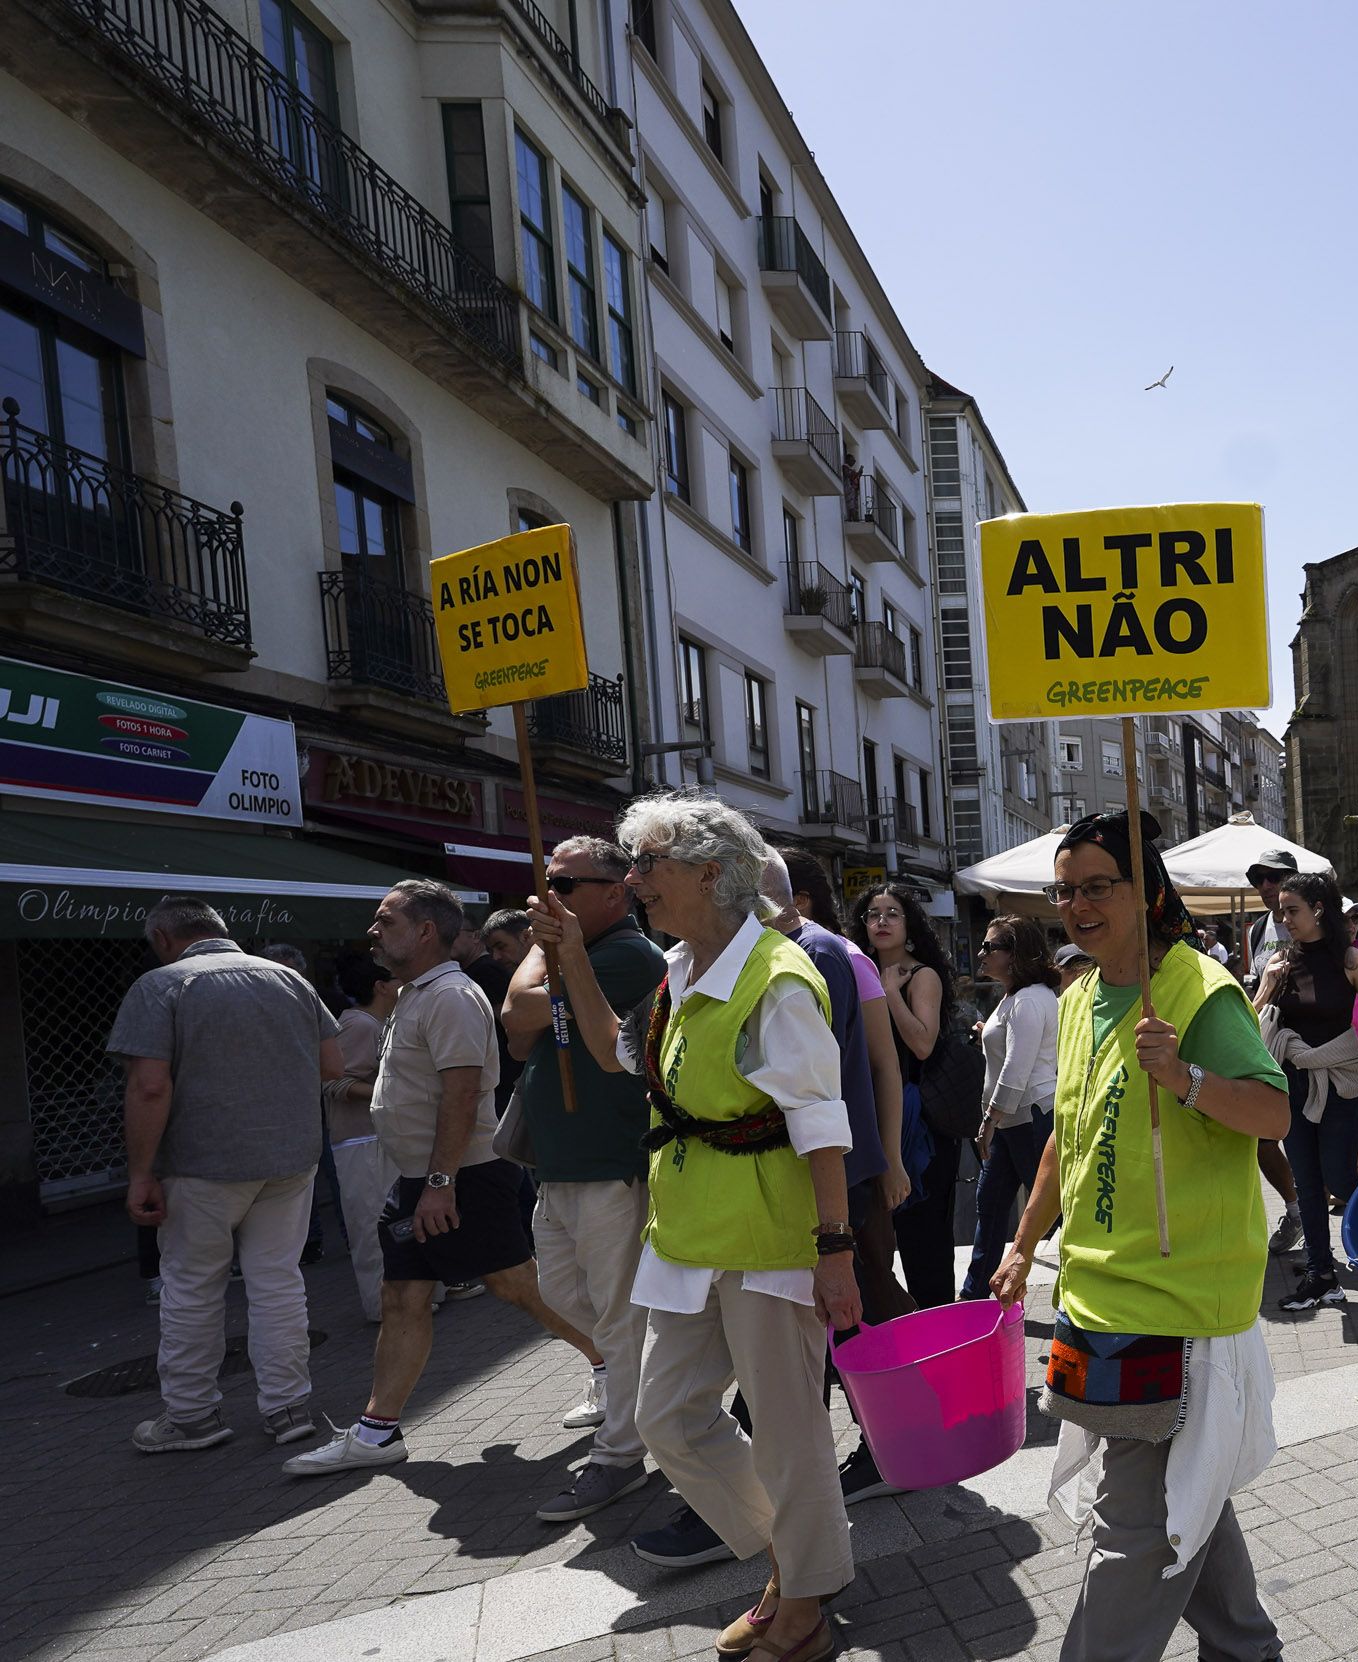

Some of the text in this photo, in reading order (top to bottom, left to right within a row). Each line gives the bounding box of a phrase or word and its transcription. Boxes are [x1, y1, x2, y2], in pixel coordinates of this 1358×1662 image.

[1006, 528, 1234, 596] ALTRI
[440, 552, 562, 611] A RÍA NON
[458, 604, 554, 652] SE TOCA
[1042, 590, 1208, 660] NÃO
[474, 658, 549, 692] GREENPEACE
[1046, 676, 1210, 708] GREENPEACE
[106, 695, 177, 718] REVELADO DIGITAL
[116, 719, 172, 738] FOTOS 1 HORA
[119, 742, 172, 760] FOTO CARNET
[241, 769, 280, 791] FOTO
[228, 793, 292, 817] OLIMPIO
[17, 888, 147, 935] Olimpio
[557, 1001, 570, 1044] CELULOSA
[1094, 1065, 1129, 1234] GREENPEACE
